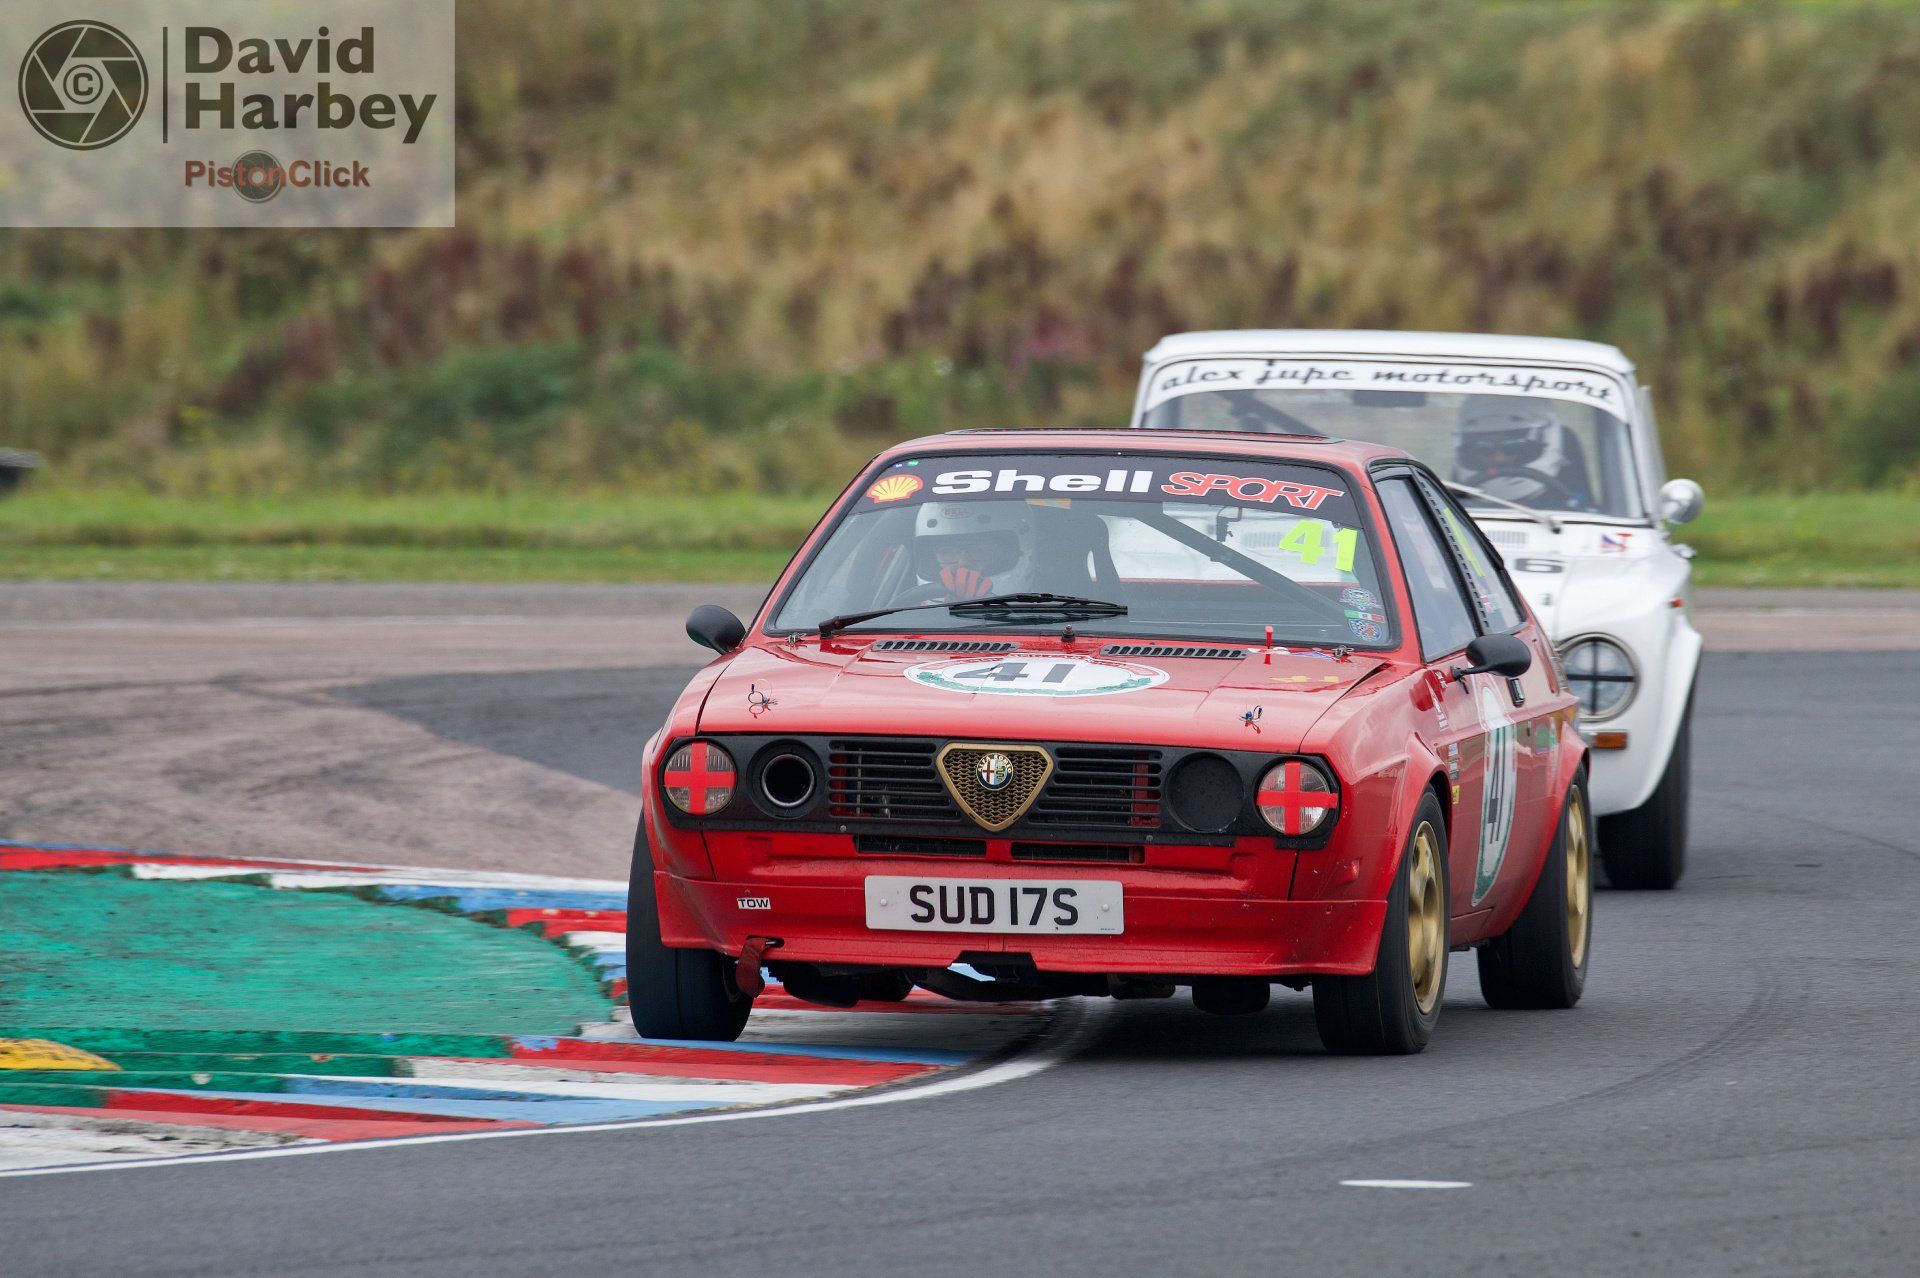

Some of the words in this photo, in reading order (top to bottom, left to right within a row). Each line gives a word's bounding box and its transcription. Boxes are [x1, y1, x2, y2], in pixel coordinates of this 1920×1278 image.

[1161, 366, 1242, 390] alex
[1255, 359, 1354, 385] jupe
[1371, 369, 1616, 402] motorsport
[931, 469, 1153, 495] Shell
[1160, 471, 1345, 510] SPORT
[1279, 519, 1358, 573] 41
[953, 662, 1077, 684] 41
[737, 898, 771, 910] TOW
[909, 884, 995, 925] SUD
[1009, 887, 1079, 926] 17S
